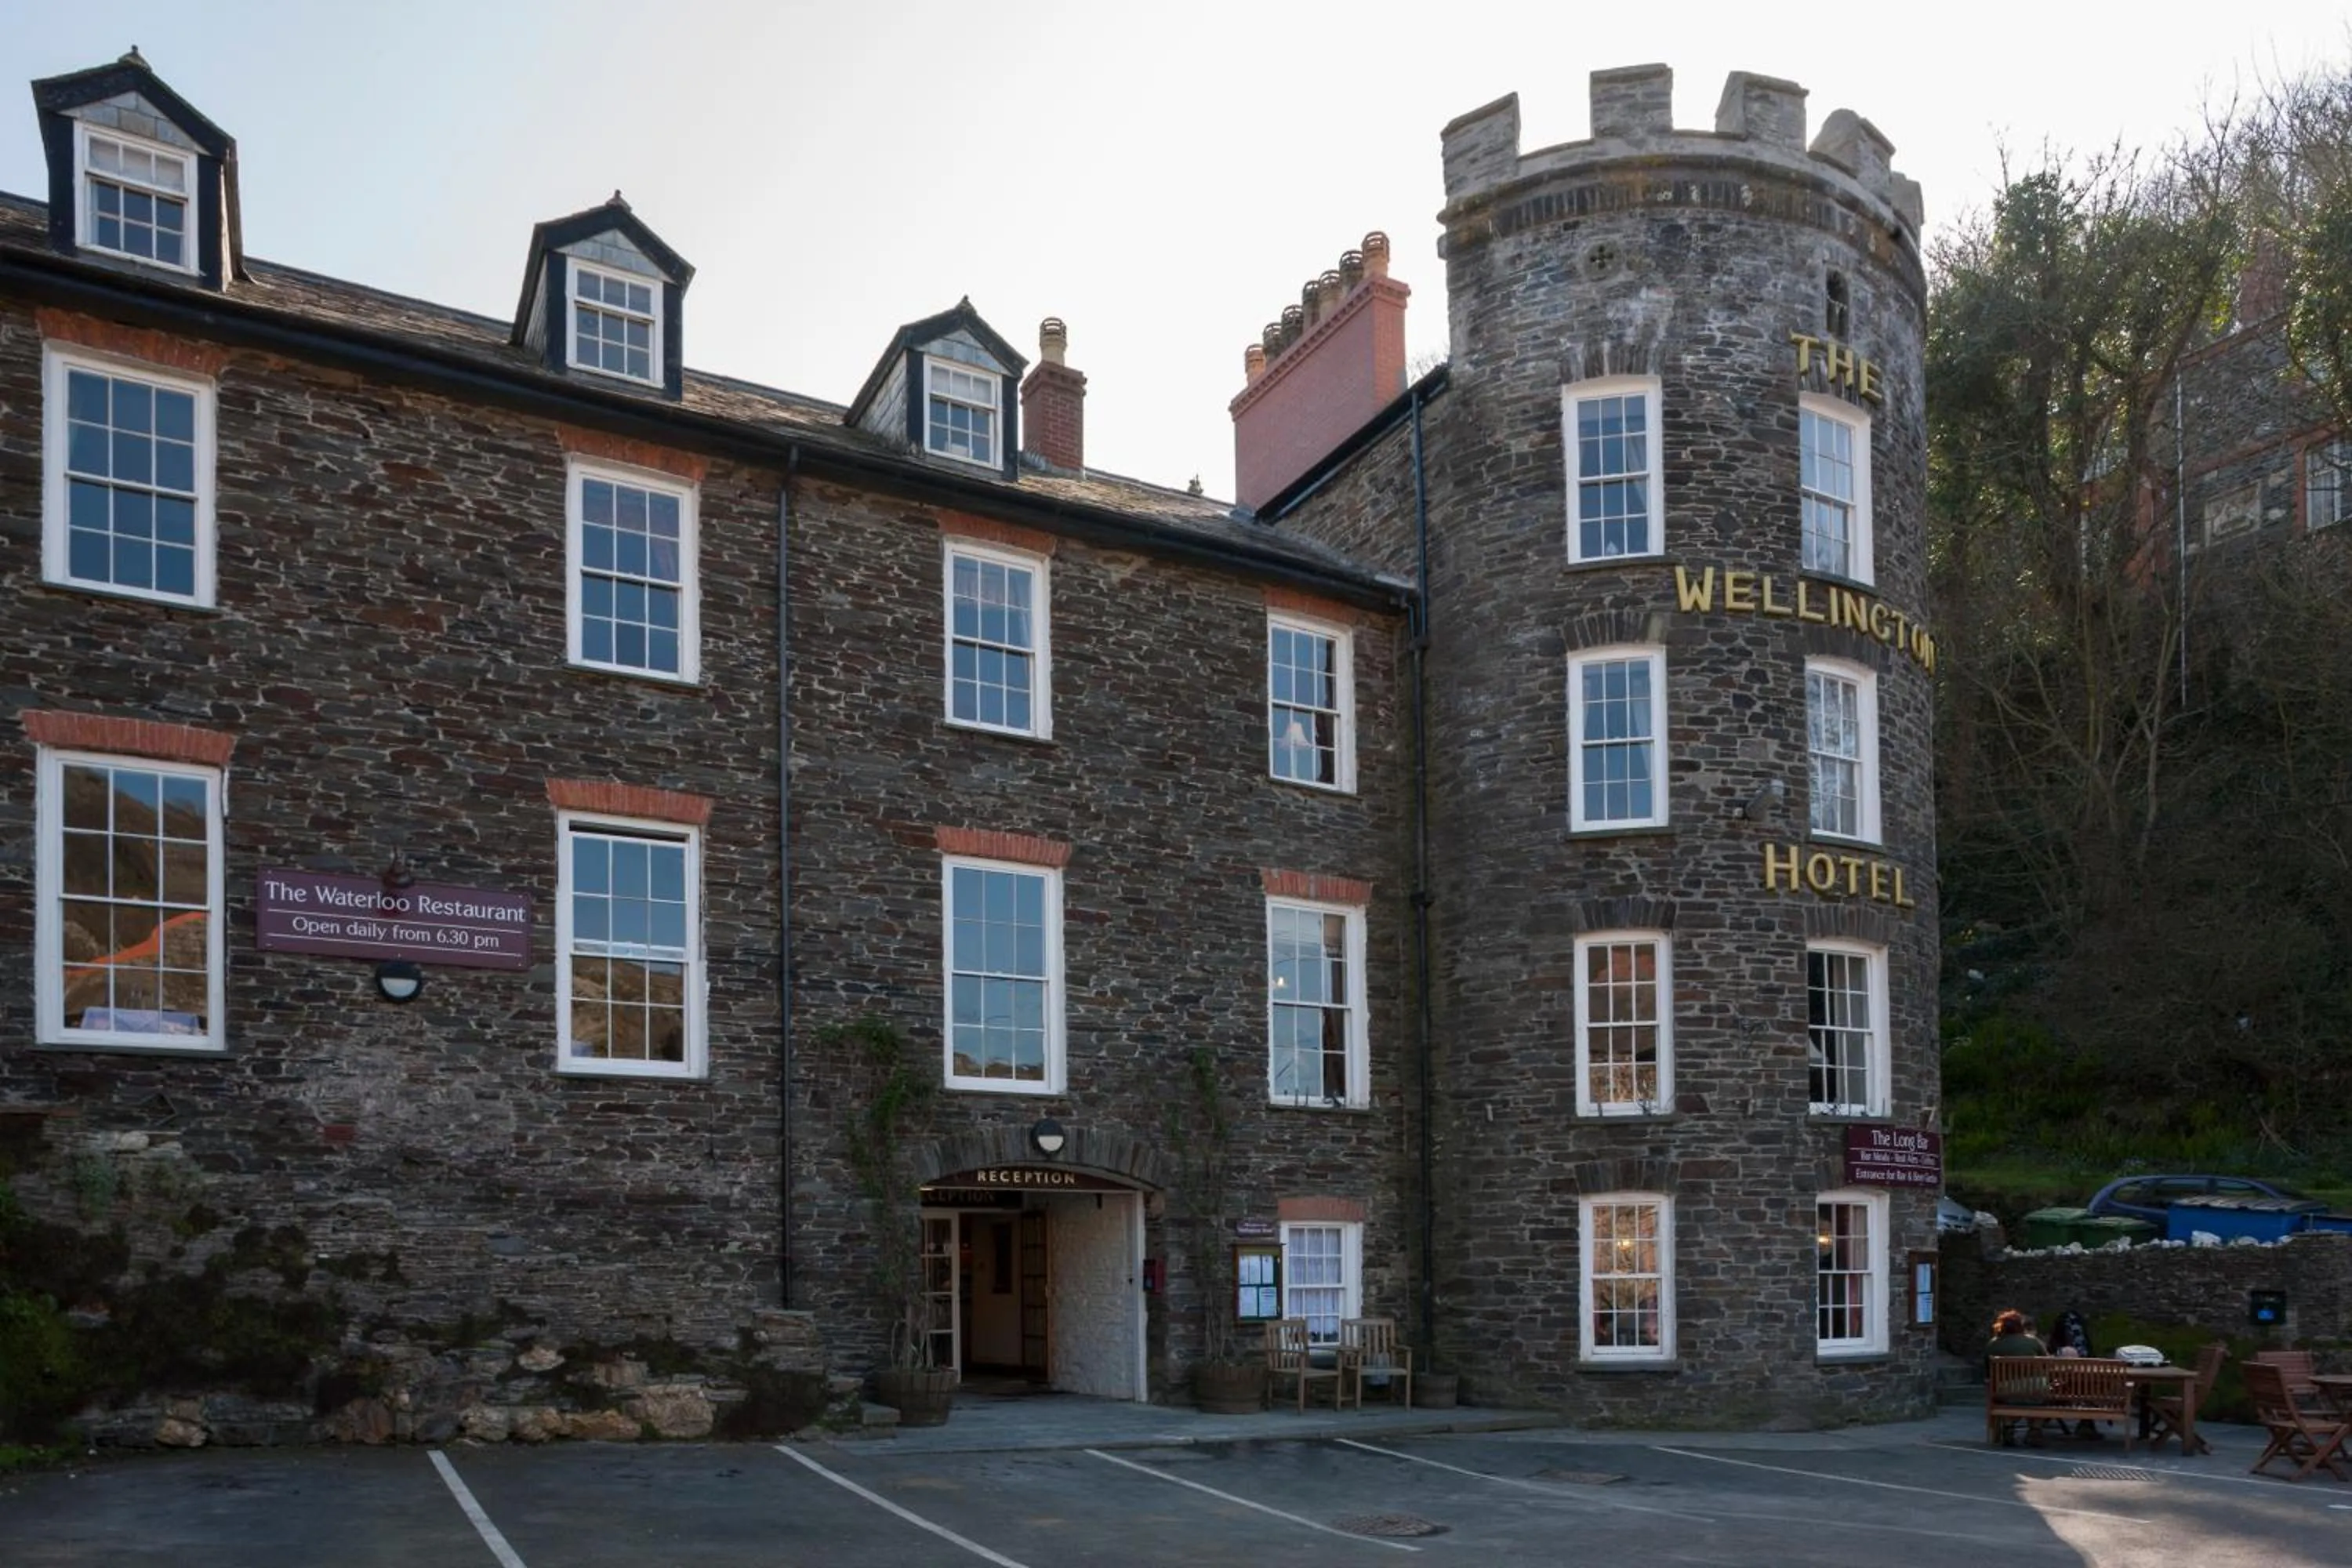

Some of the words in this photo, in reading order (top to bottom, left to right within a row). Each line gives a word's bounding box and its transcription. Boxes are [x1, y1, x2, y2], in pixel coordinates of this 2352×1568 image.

[1789, 332, 1882, 401] THE
[1675, 565, 1936, 676] WELLINGTON
[1766, 843, 1915, 907] HOTEL
[264, 880, 307, 902] The
[315, 885, 410, 913] Waterloo
[419, 895, 527, 923] Restaurant
[292, 916, 340, 935] Open
[347, 921, 387, 941] daily
[393, 925, 430, 942] from
[437, 927, 469, 945] 6.30
[474, 933, 499, 949] pm
[1871, 1130, 1890, 1146] The
[1893, 1131, 1915, 1151] Long
[978, 1170, 1076, 1185] RECEPTION
